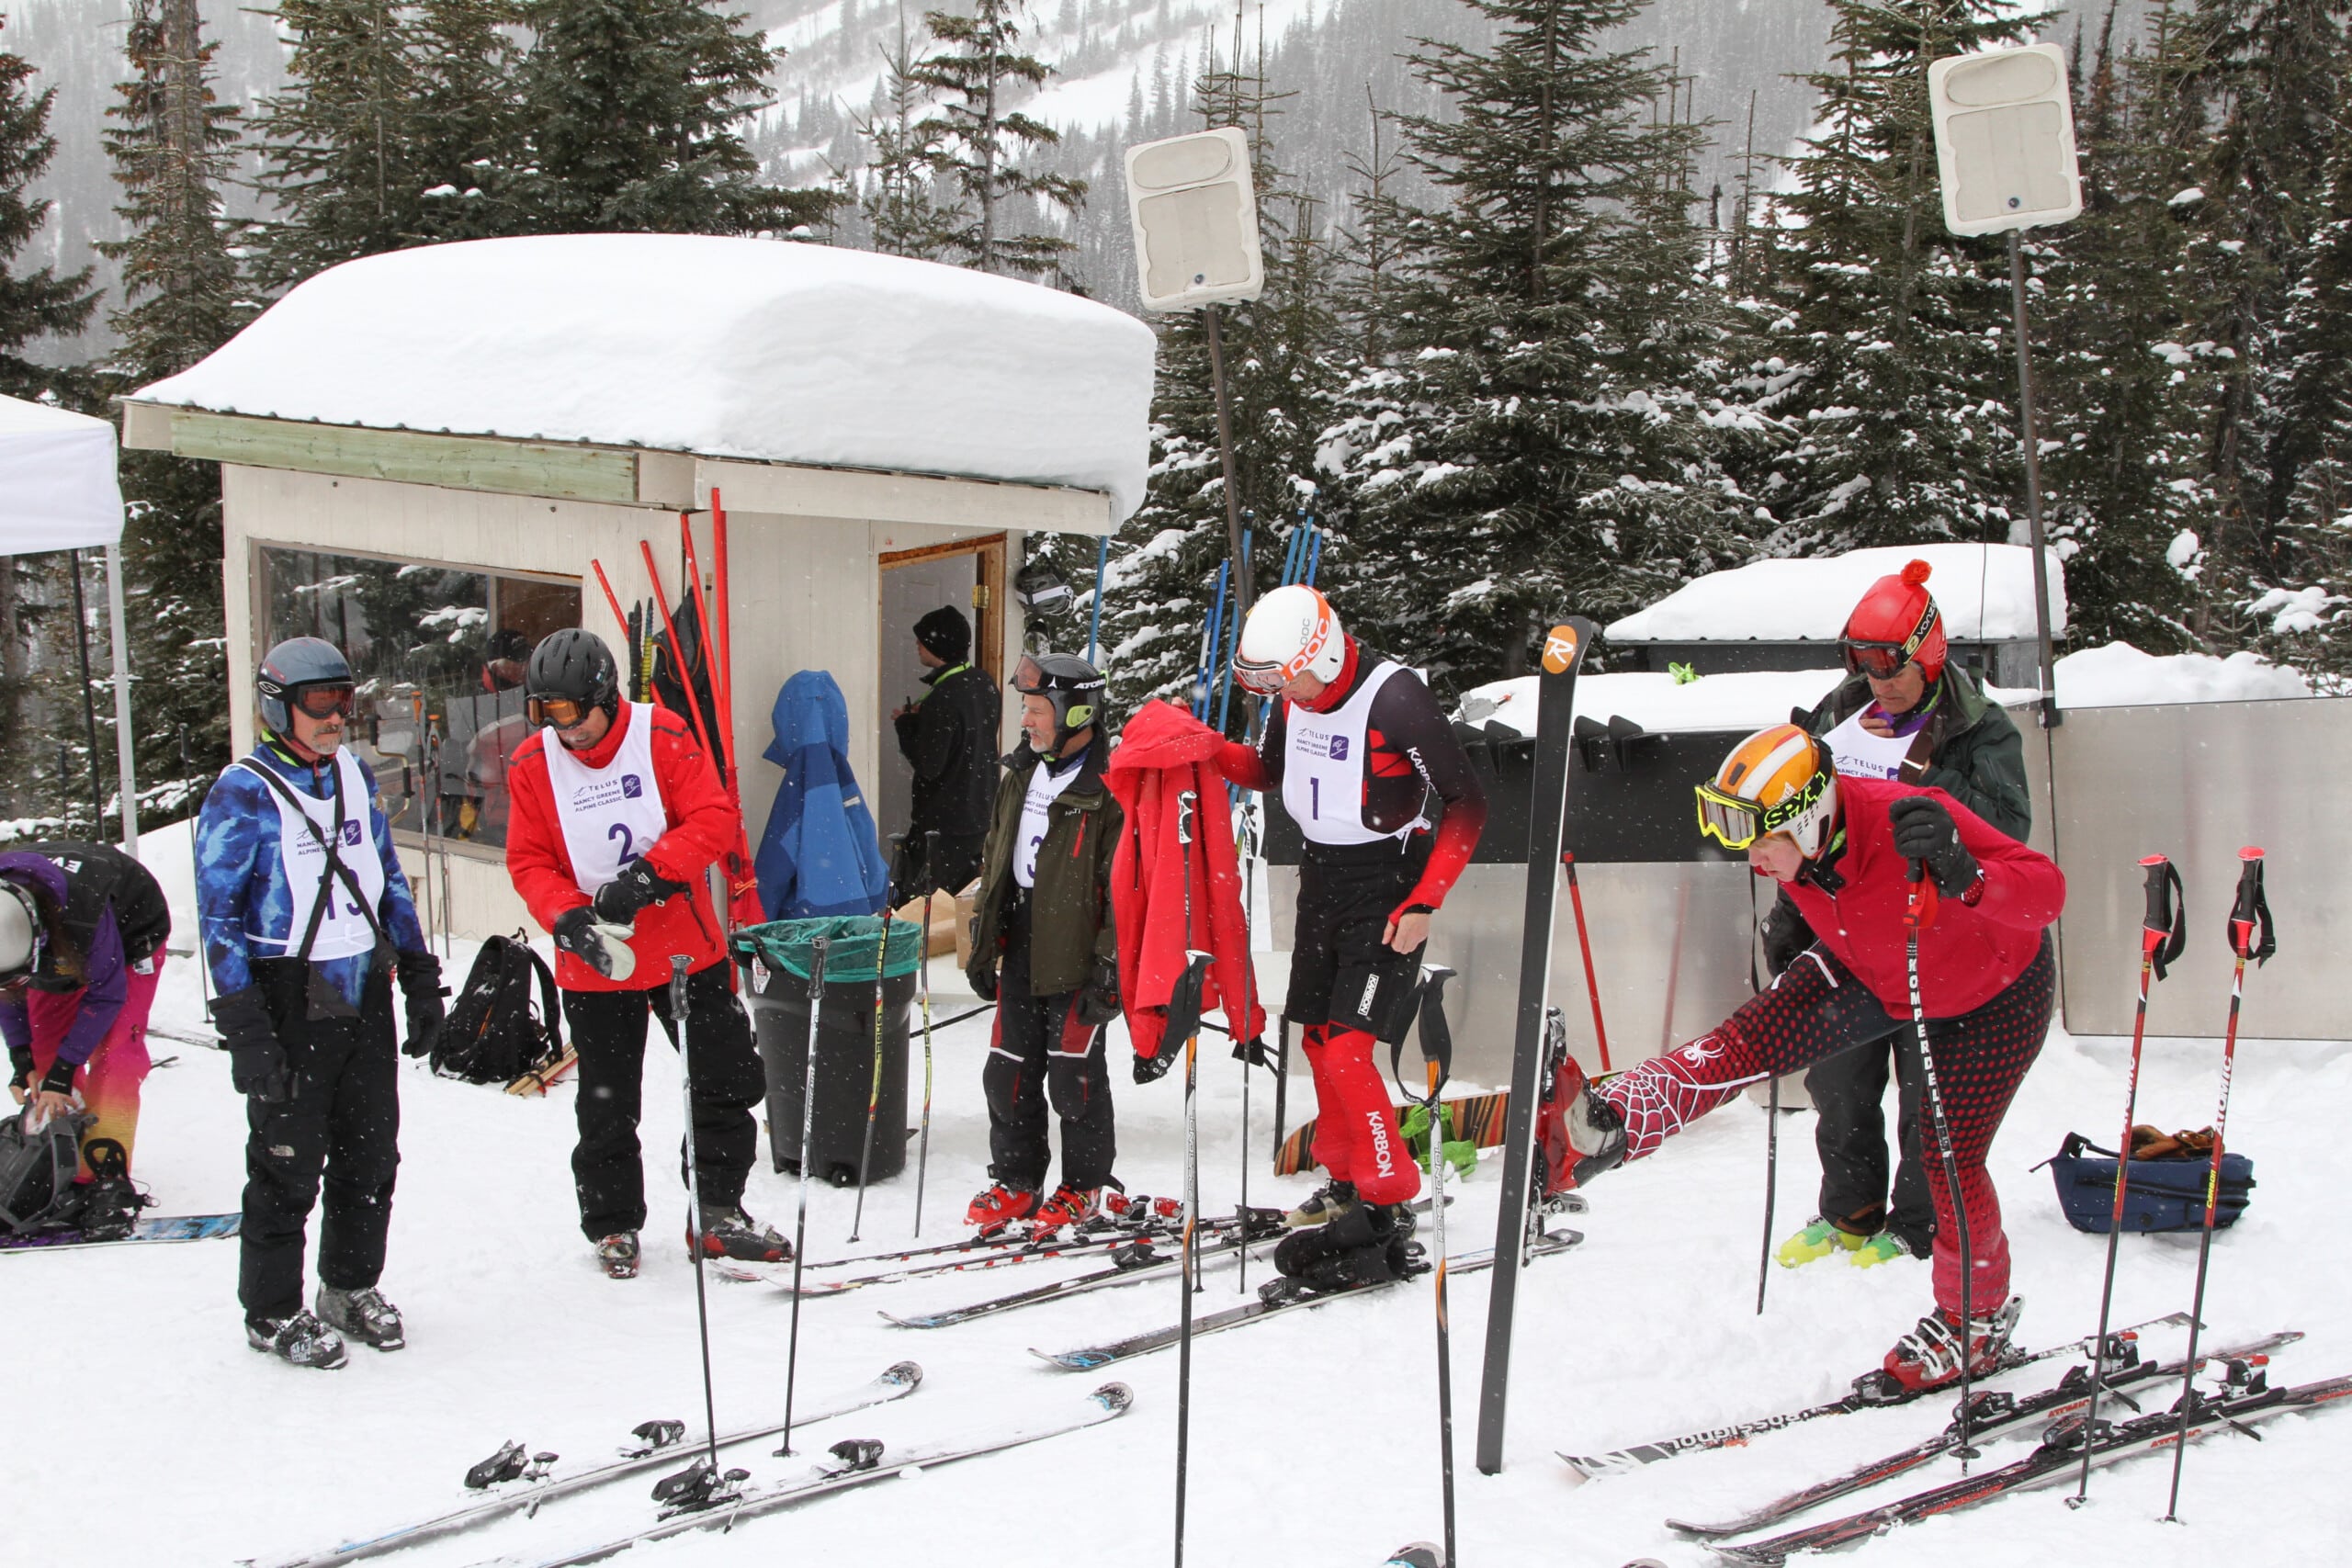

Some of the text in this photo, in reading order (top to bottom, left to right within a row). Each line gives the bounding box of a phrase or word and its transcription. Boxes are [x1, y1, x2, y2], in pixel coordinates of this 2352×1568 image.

[1288, 617, 1330, 677] POC
[1308, 729, 1329, 741] TELUS
[1852, 758, 1884, 773] TELUS
[573, 789, 621, 806] NANCY GREENE
[588, 778, 618, 792] TELUS
[1310, 776, 1319, 821] 1
[574, 795, 623, 813] ALPINE CLASSIC
[298, 846, 321, 856] ALPINE
[607, 822, 639, 867] 2
[1359, 975, 1379, 1015] KARBON
[2215, 1055, 2233, 1137] ATOMIC
[1366, 1111, 1395, 1179] KARBON
